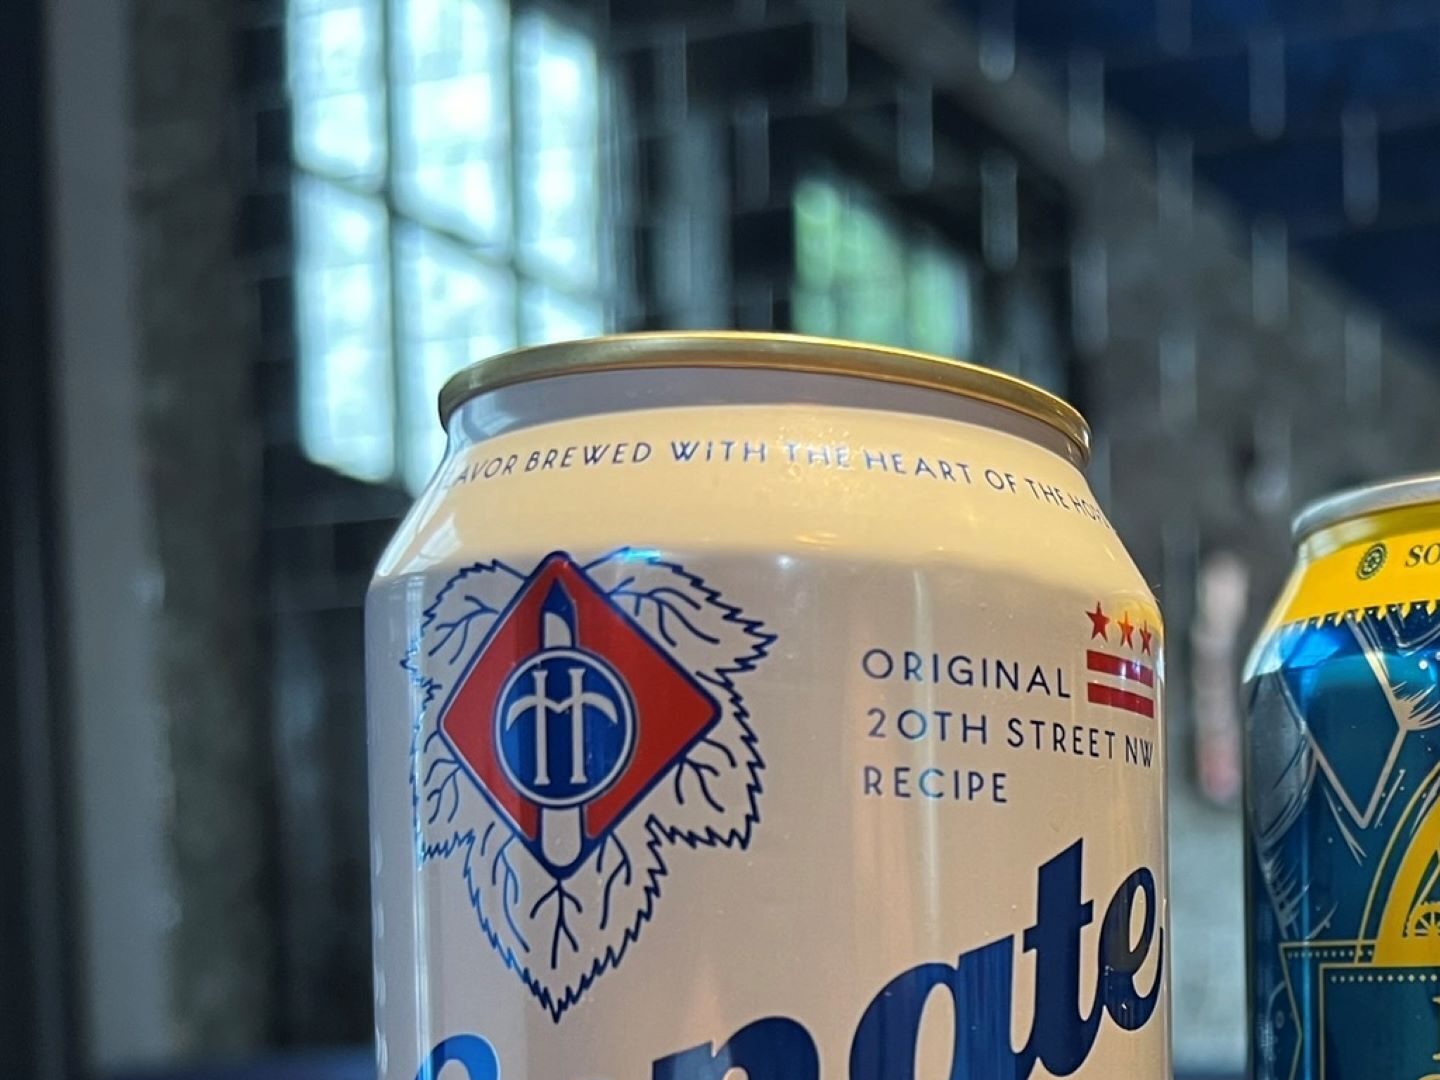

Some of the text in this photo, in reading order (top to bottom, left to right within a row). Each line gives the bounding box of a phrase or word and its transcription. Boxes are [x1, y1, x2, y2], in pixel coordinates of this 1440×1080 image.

[523, 442, 653, 472] BREWED
[670, 440, 766, 463] WITH
[786, 443, 850, 468] THE
[865, 451, 972, 484] HEART
[985, 468, 1016, 494] OF
[1025, 477, 1070, 510] THE
[862, 648, 1071, 699] ORIGINAL
[867, 707, 1154, 768] 20TH STREET NW
[863, 765, 1008, 804] RECIPE
